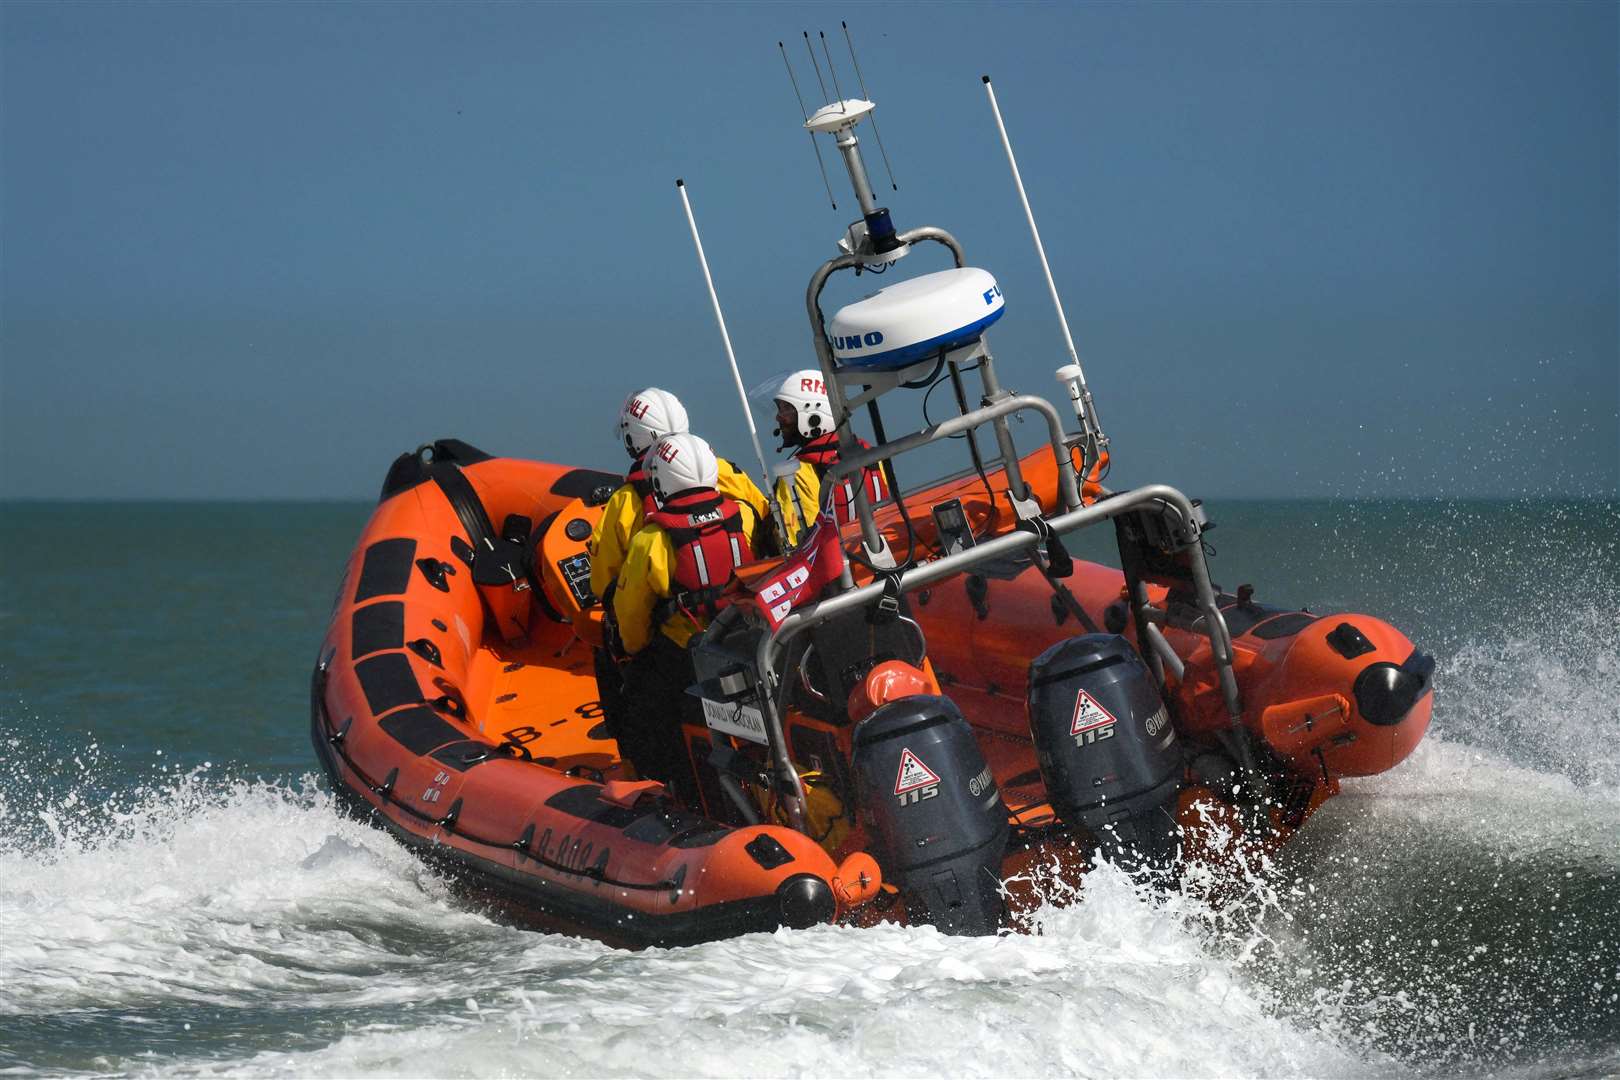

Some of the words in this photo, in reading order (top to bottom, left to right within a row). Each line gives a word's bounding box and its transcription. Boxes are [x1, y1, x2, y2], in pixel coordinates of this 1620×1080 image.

[983, 285, 1001, 305] FU
[801, 378, 828, 395] RN
[1074, 724, 1115, 748] 115
[898, 783, 940, 807] 115
